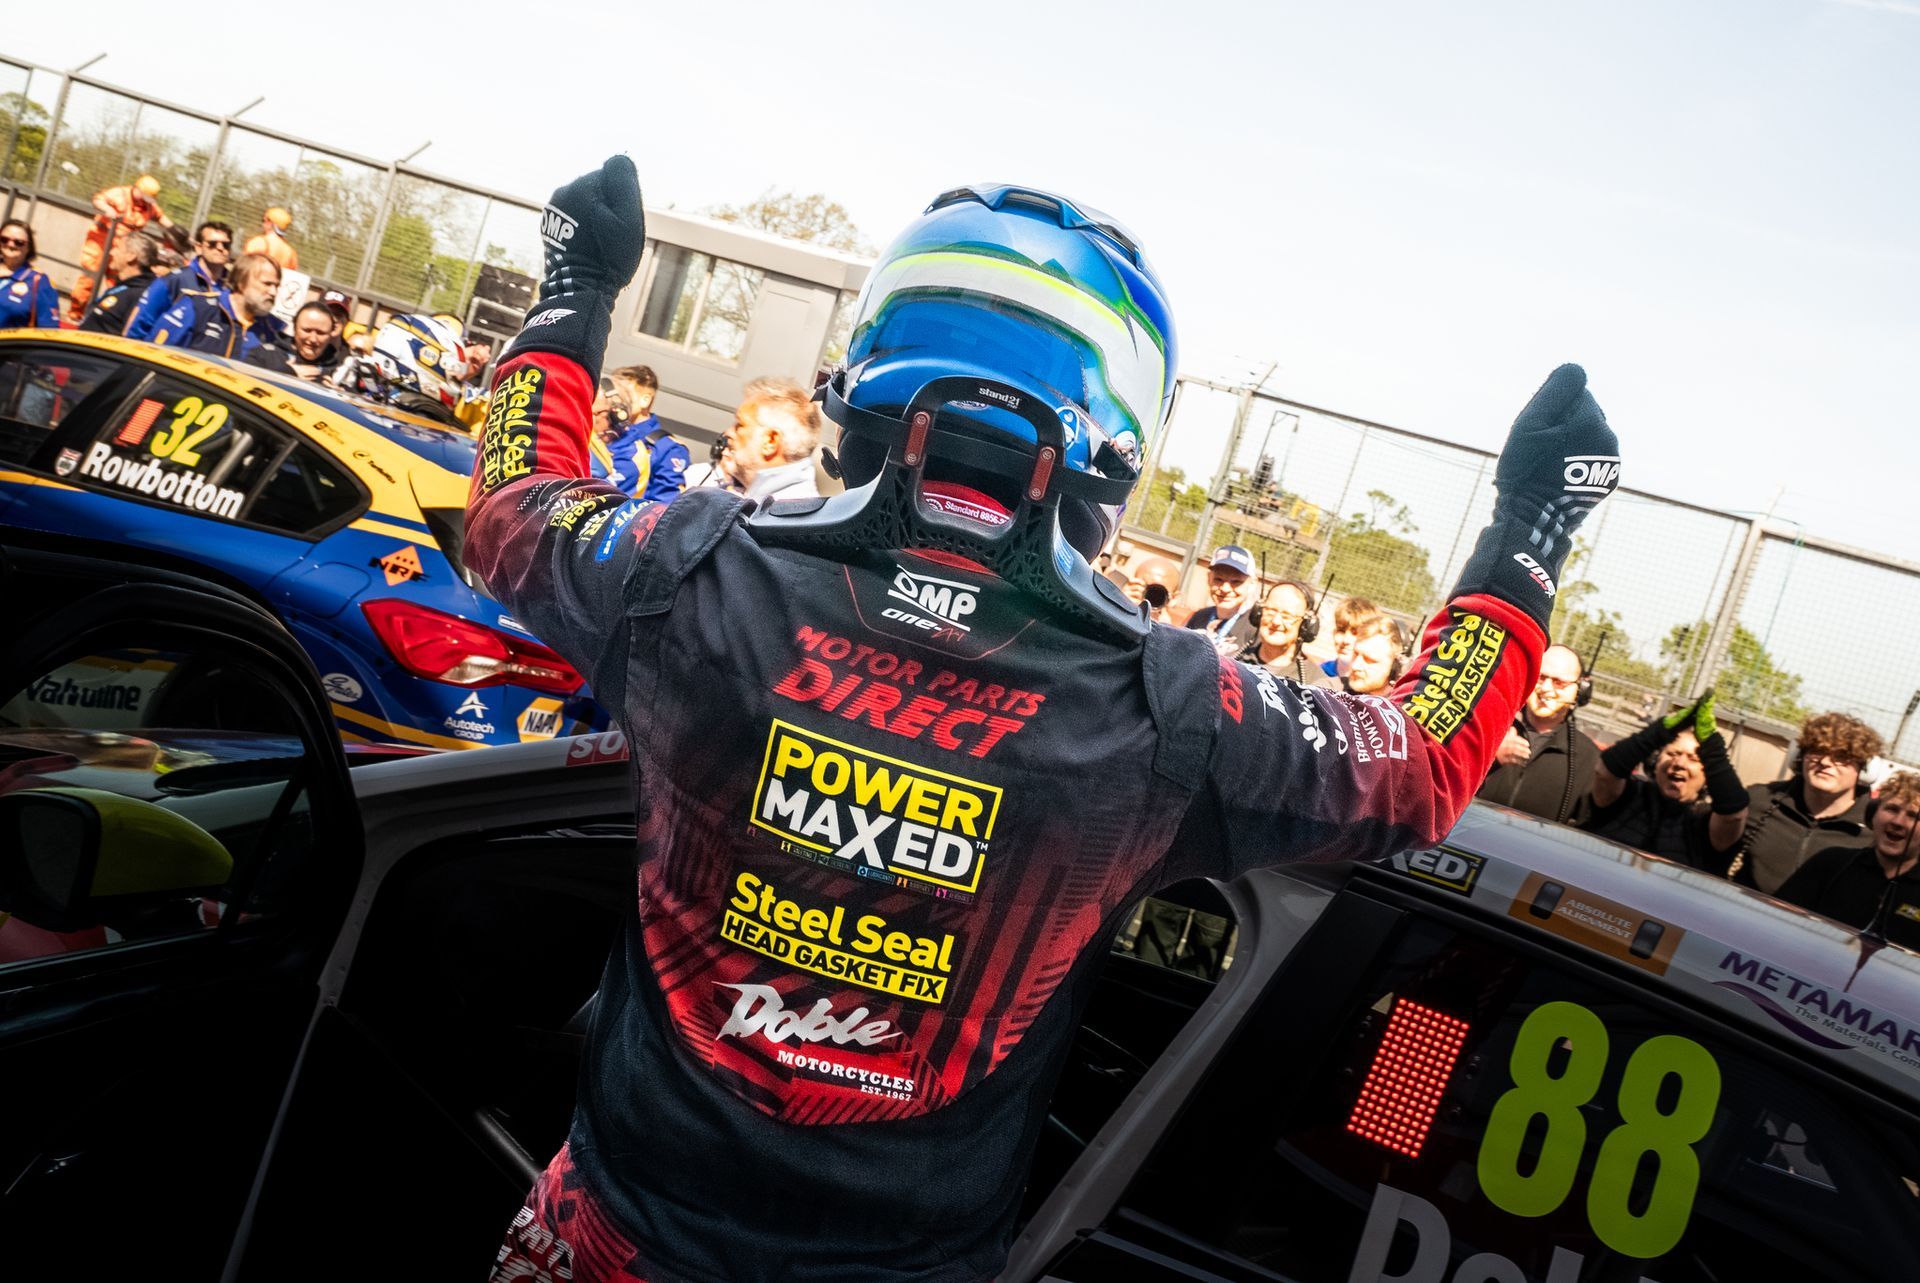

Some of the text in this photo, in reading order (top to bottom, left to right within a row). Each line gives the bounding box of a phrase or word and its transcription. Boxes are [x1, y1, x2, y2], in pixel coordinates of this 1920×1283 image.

[150, 396, 229, 468] 32
[502, 368, 542, 480] Steel Sea
[80, 441, 245, 519] Rowbottom
[1564, 462, 1620, 487] OMP
[559, 498, 597, 532] Seal
[945, 501, 980, 519] Standard
[893, 570, 977, 621] OMP
[794, 625, 1047, 717] MOTOR PARTS
[1402, 664, 1458, 725] Steel
[1428, 699, 1466, 740] HEAD
[1455, 640, 1496, 700] GASKET
[445, 716, 495, 735] Autotech
[527, 710, 557, 734] NAPA
[772, 657, 1027, 759] DIRECT
[1358, 706, 1388, 759] POWER
[454, 729, 484, 741] GROUP
[570, 732, 626, 759] SU
[773, 734, 984, 838] POWER
[762, 779, 975, 879] MAXED
[730, 872, 956, 973] Steel Seal
[1558, 905, 1633, 939] ALIGNMENT
[1567, 898, 1633, 930] ABSOLUTE
[724, 917, 945, 1000] HEAD GASKET FIX
[711, 980, 903, 1047] Doble
[1794, 1005, 1819, 1022] The
[1823, 1018, 1888, 1054] Materials
[777, 1050, 915, 1091] MOTORCYCLES
[860, 1084, 912, 1101] EST. 1967
[1477, 1001, 1722, 1259] 88
